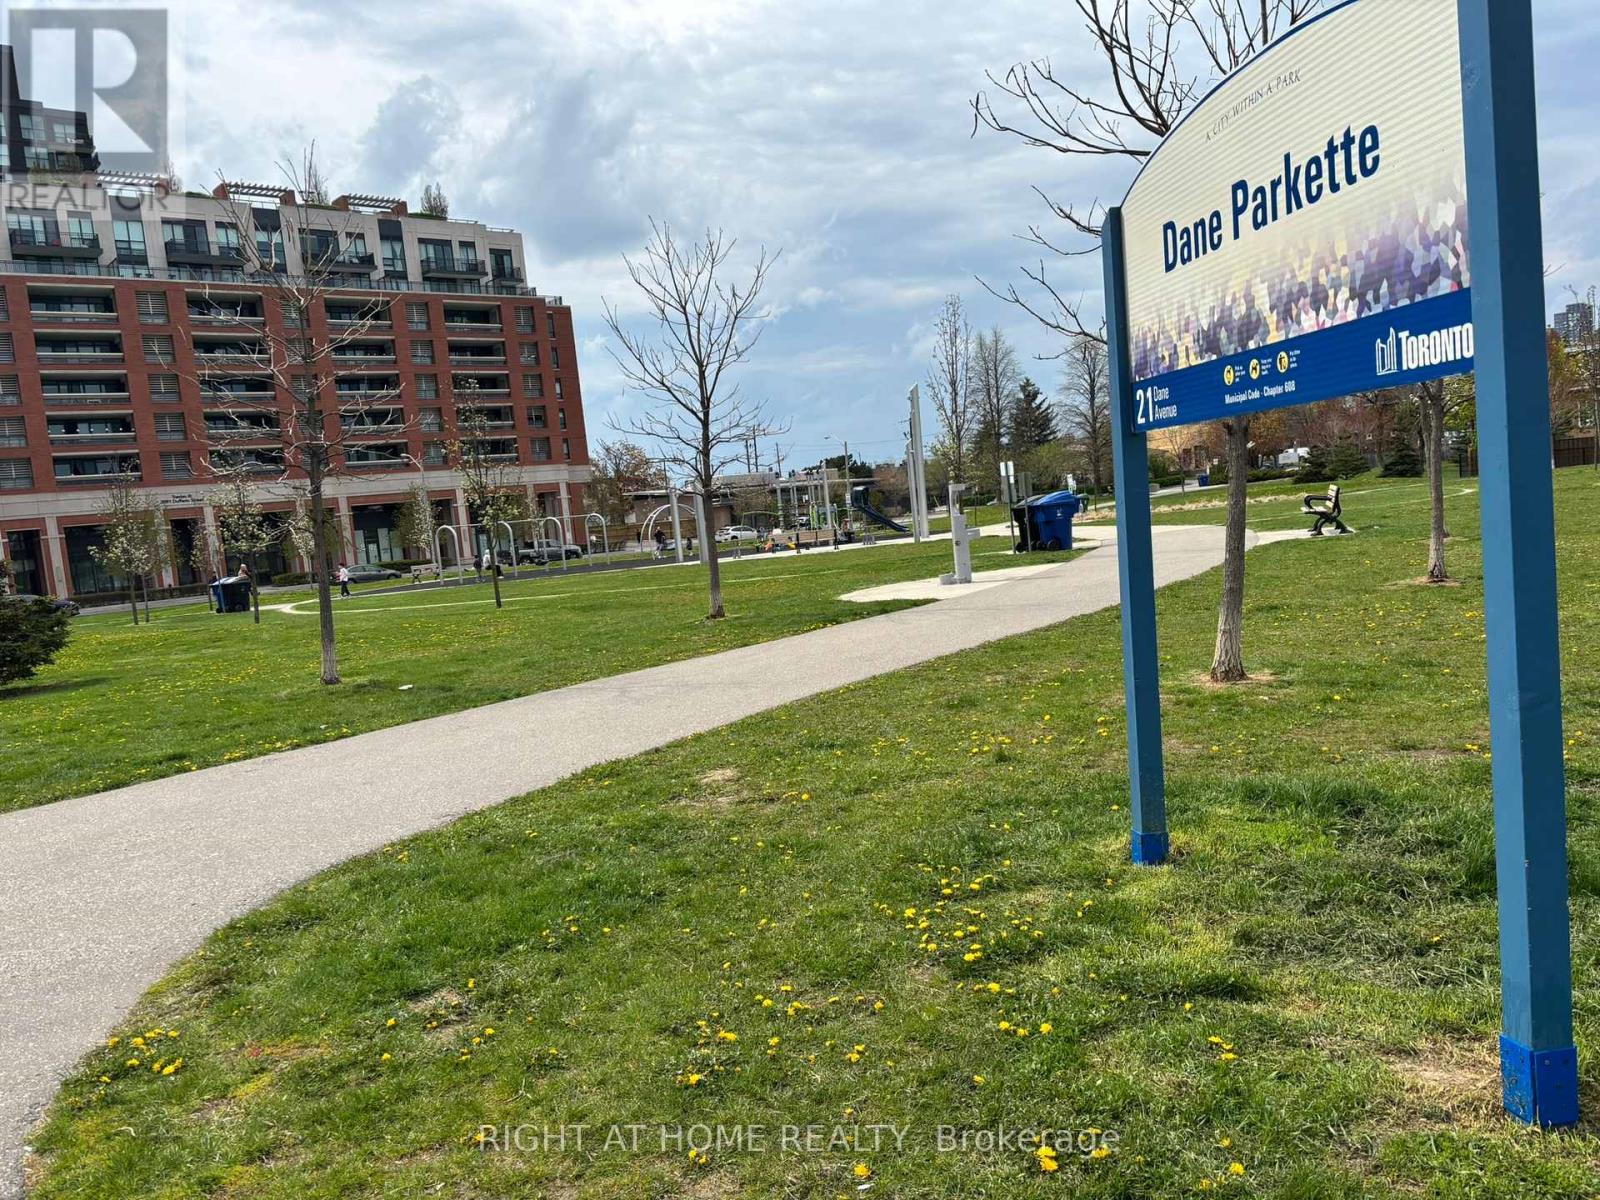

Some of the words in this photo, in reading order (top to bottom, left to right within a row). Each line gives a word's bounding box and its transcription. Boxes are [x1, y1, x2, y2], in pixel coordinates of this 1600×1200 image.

[1212, 112, 1229, 136] CITY
[1232, 89, 1264, 118] WITHIN
[1276, 68, 1301, 90] PARK
[1162, 209, 1223, 273] Dane
[1231, 124, 1381, 241] Parkette
[1397, 322, 1475, 371] TORONTO
[1136, 386, 1153, 424] 21
[1153, 385, 1170, 402] Dane
[1154, 404, 1178, 420] Avenue
[1225, 390, 1247, 404] Municipal
[1248, 388, 1260, 399] Code
[1263, 384, 1284, 397] Chapter
